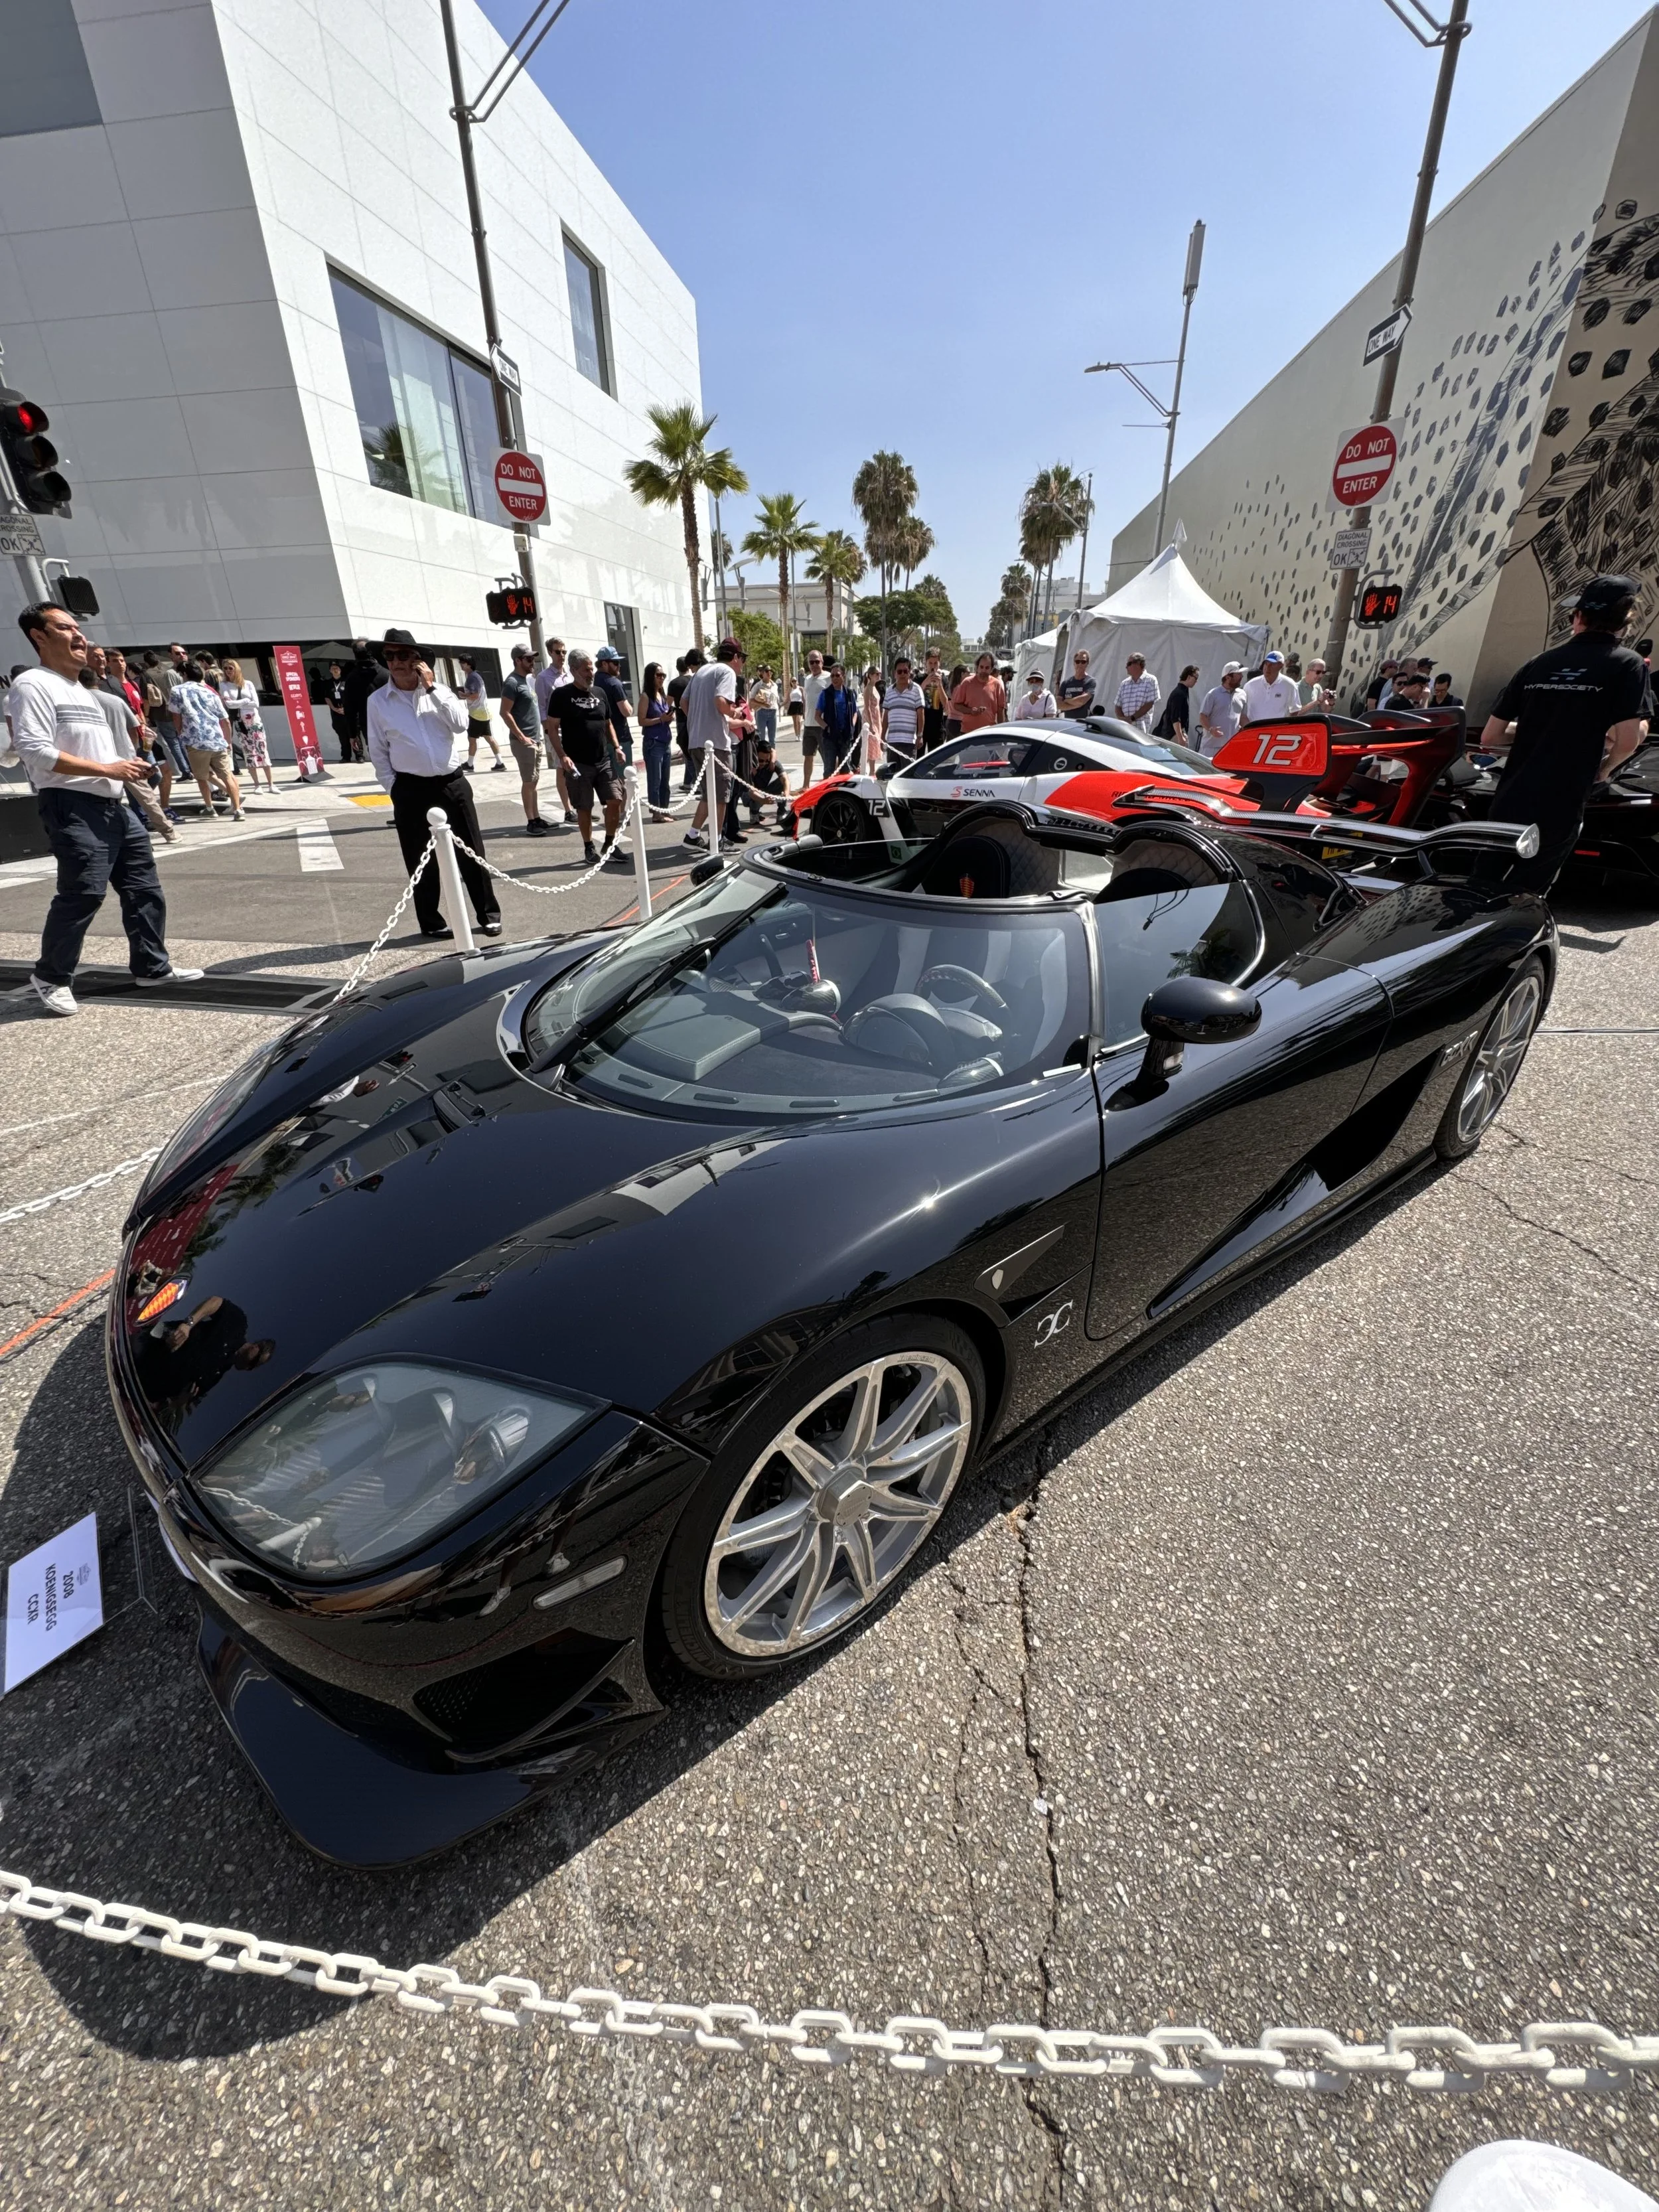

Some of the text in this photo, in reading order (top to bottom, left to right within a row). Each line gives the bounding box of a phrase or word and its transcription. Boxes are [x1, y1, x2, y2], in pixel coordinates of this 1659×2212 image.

[1368, 324, 1397, 354] ONE WAY
[1346, 437, 1390, 459] DO NOT
[500, 463, 536, 480] DO NOT
[1342, 476, 1378, 494] ENTER
[508, 495, 538, 510] ENTER
[1, 537, 21, 551] OK
[1337, 539, 1367, 549] CROSSING
[1338, 532, 1368, 541] DIAGONAL
[1334, 553, 1348, 565] OK
[522, 597, 534, 614] 14
[1383, 595, 1398, 614] 14
[1524, 684, 1603, 692] HYPERSOCIETY
[1252, 734, 1302, 766] 12
[963, 788, 995, 798] SENNA
[868, 799, 886, 816] 12
[62, 1570, 74, 1599] 2008
[45, 1563, 57, 1631] KOENIGSEGG
[27, 1593, 39, 1625] CCXR
